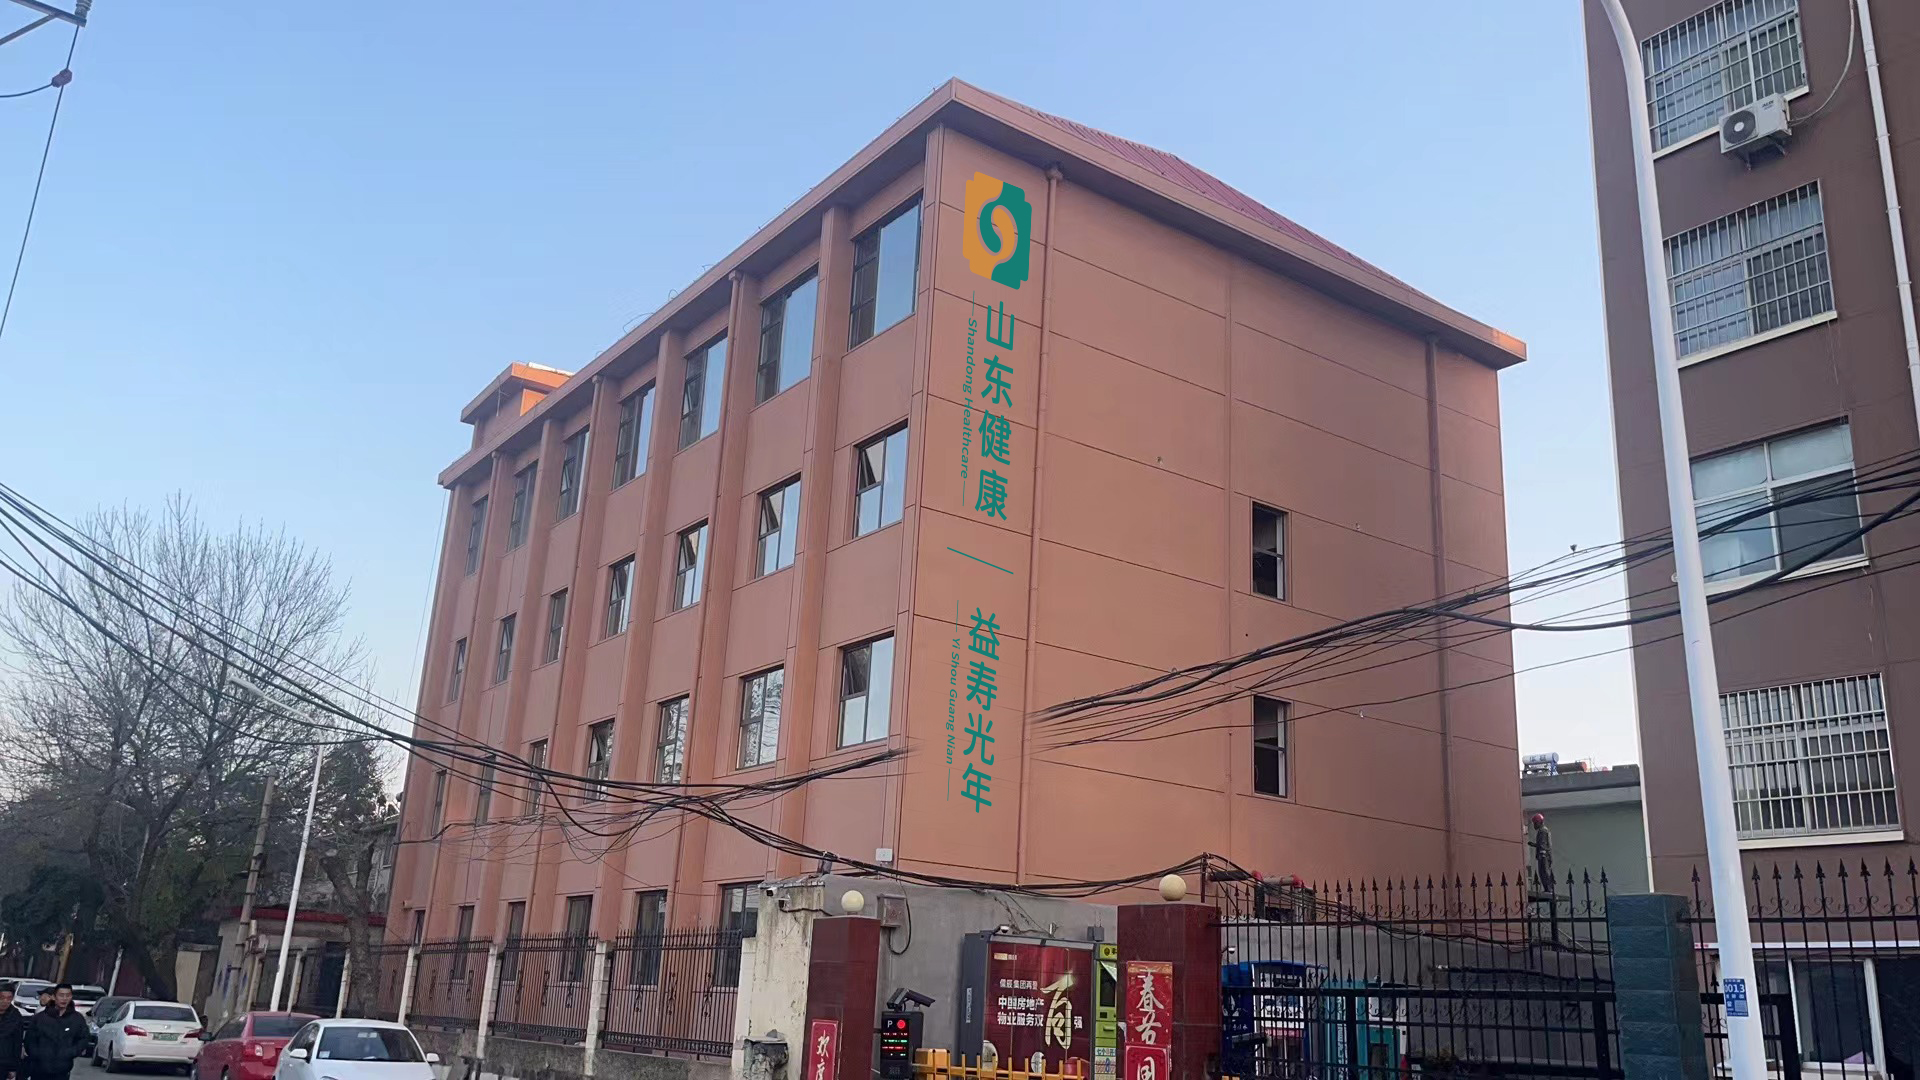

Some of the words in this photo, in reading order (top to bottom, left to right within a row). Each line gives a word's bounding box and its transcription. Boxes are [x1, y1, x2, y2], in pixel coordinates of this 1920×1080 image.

[962, 317, 978, 396] Shandong
[974, 300, 1015, 521] 山东健康
[960, 397, 974, 479] Healthcare
[952, 637, 961, 650] Yi
[950, 651, 960, 686] Shou
[945, 688, 958, 733] Guang
[960, 606, 1001, 814] 益寿光年
[945, 735, 956, 765] Nian
[998, 995, 1044, 1011] 中国房地产
